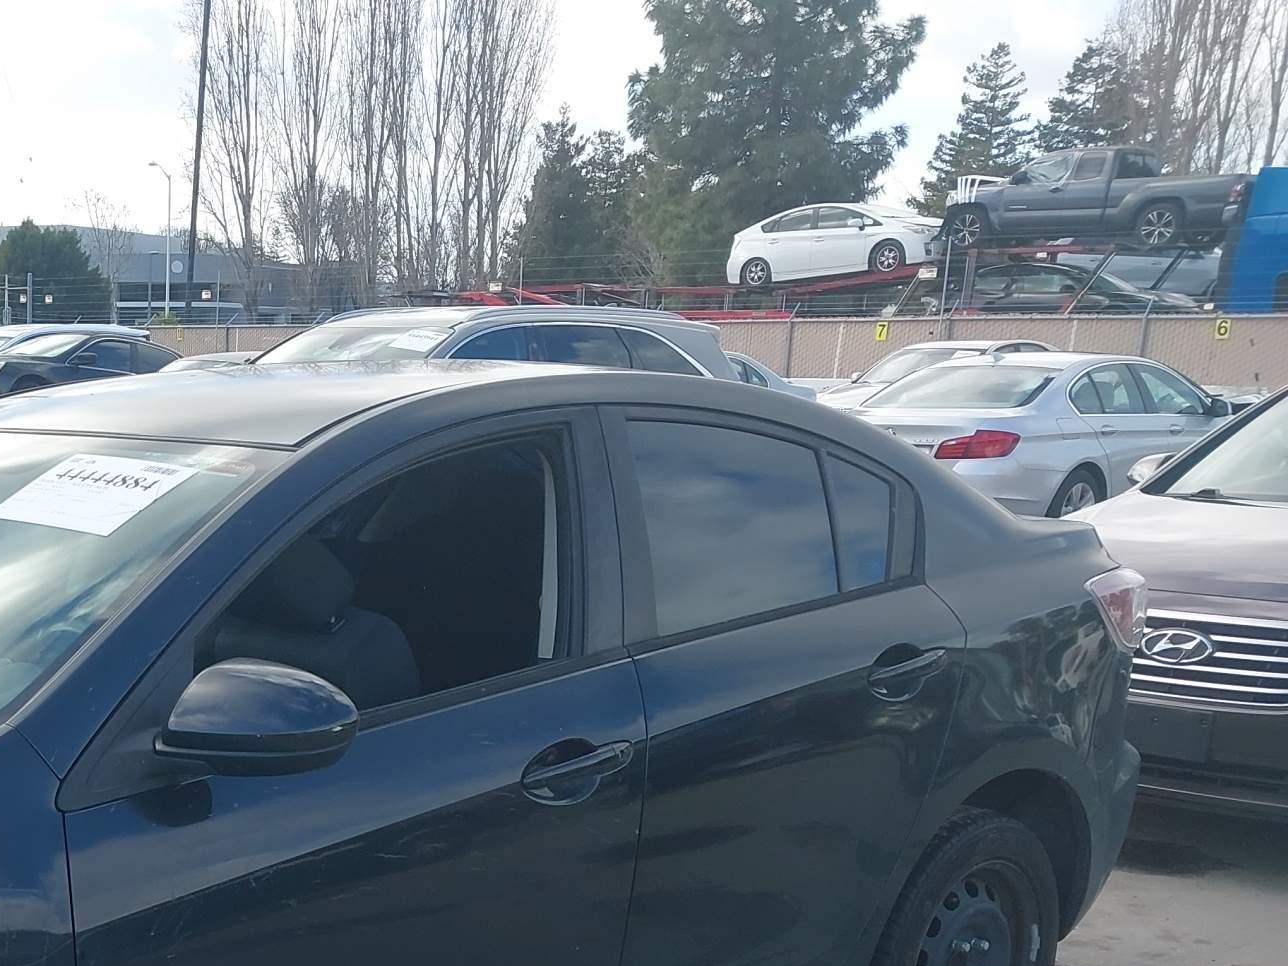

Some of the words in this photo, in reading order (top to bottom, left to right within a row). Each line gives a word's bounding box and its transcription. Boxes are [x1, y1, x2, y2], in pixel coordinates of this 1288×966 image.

[878, 324, 886, 339] 7
[1217, 319, 1228, 336] 6
[55, 468, 160, 491] 44444884
